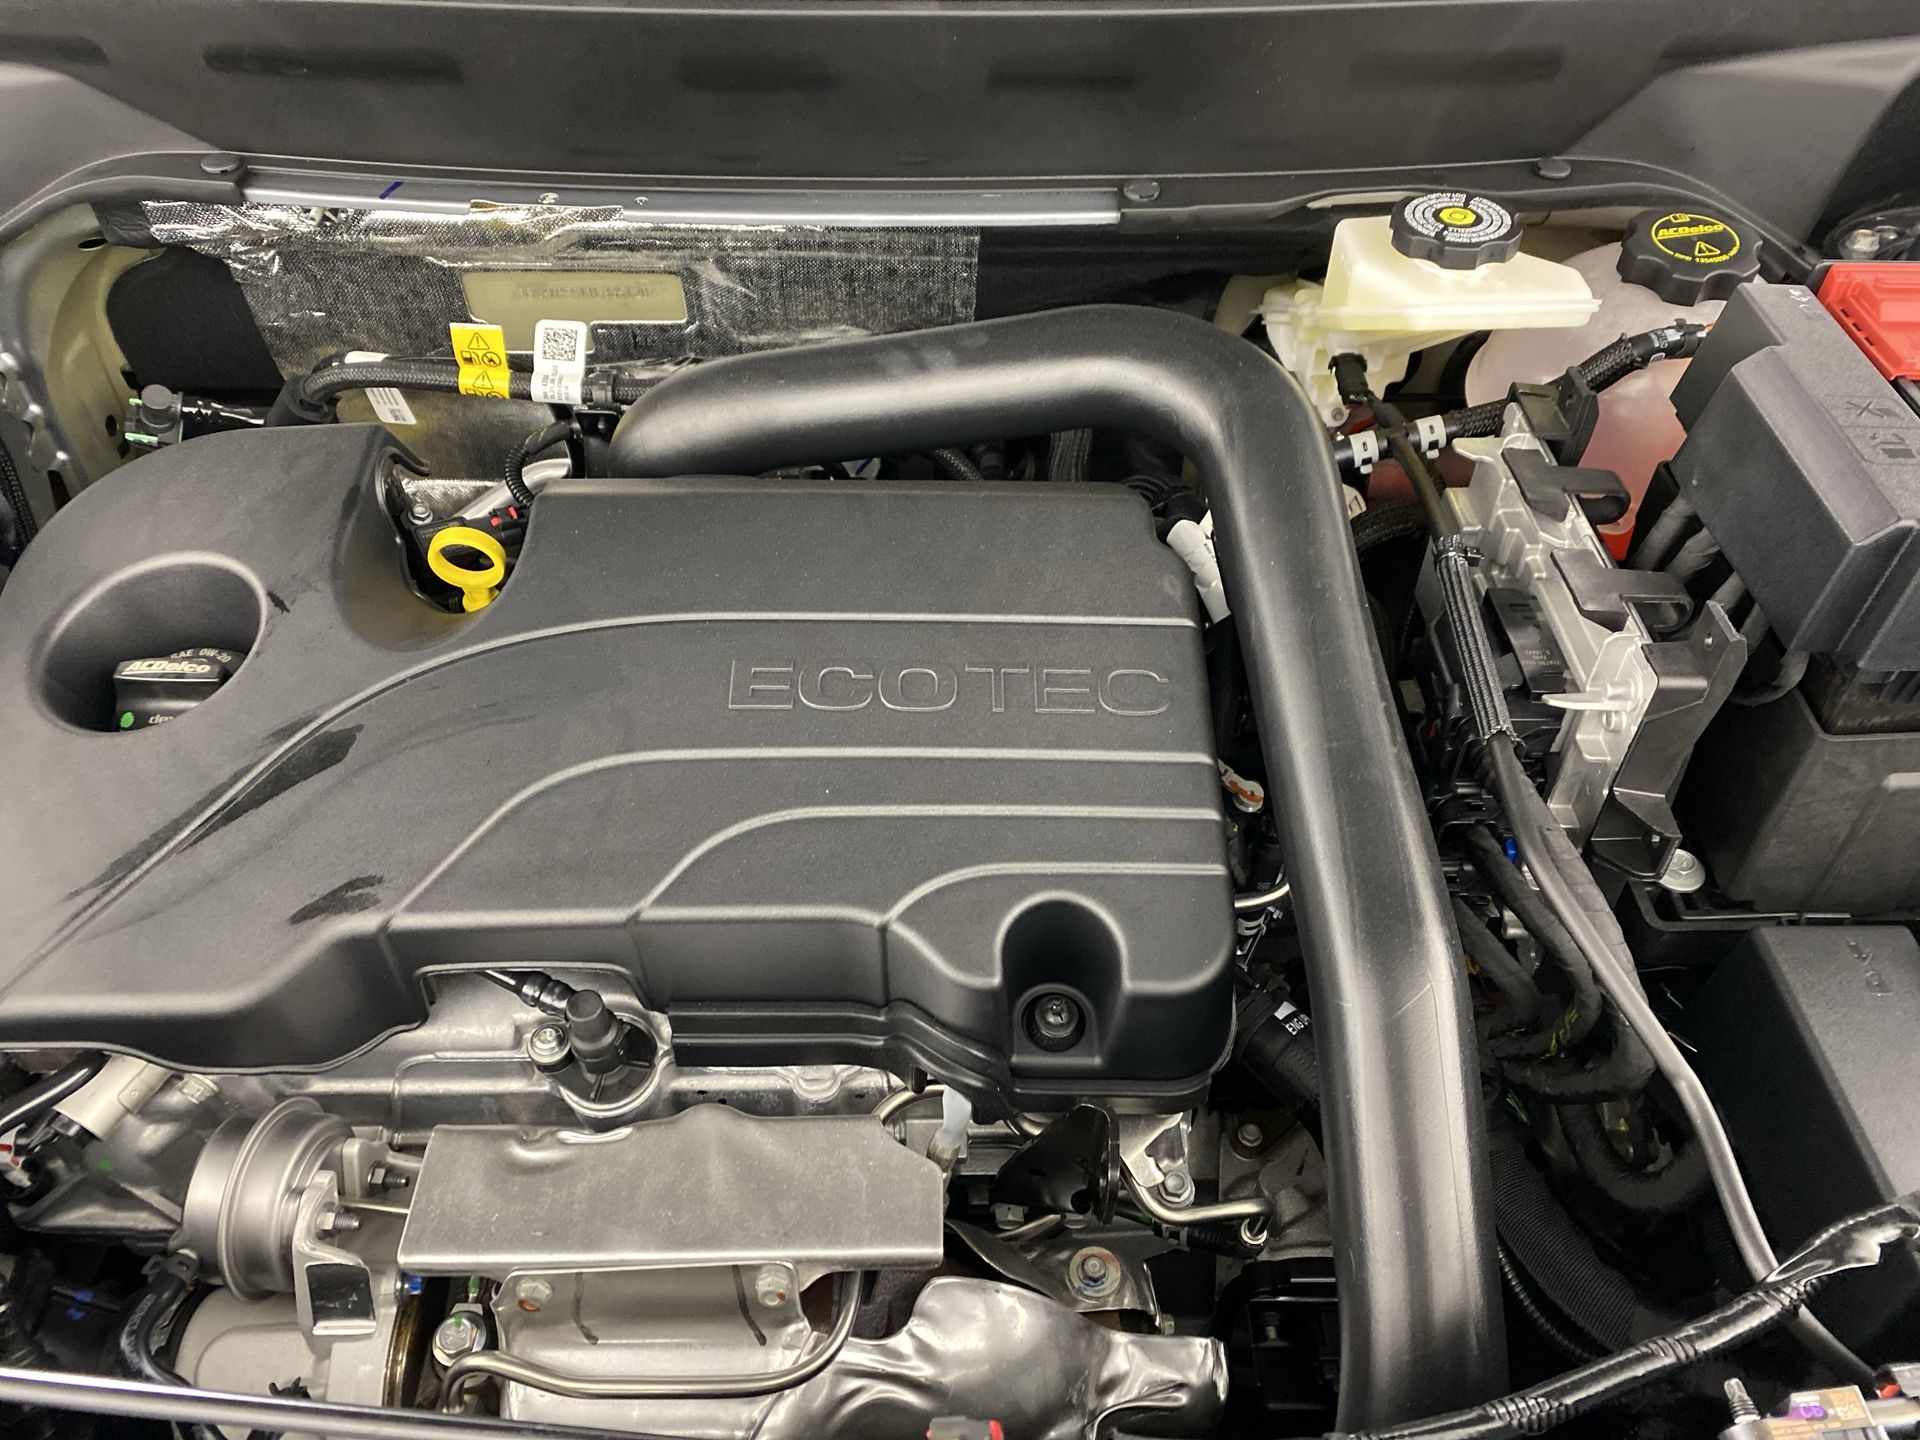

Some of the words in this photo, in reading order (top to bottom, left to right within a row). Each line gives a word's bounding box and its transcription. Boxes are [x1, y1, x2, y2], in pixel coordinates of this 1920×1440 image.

[1657, 224, 1725, 237] ACDelco
[171, 649, 194, 659] SAE
[199, 648, 232, 663] 0W-20
[123, 661, 211, 673] ACDelco
[728, 660, 1169, 716] ECOTEC
[1285, 1018, 1304, 1035] ENG
